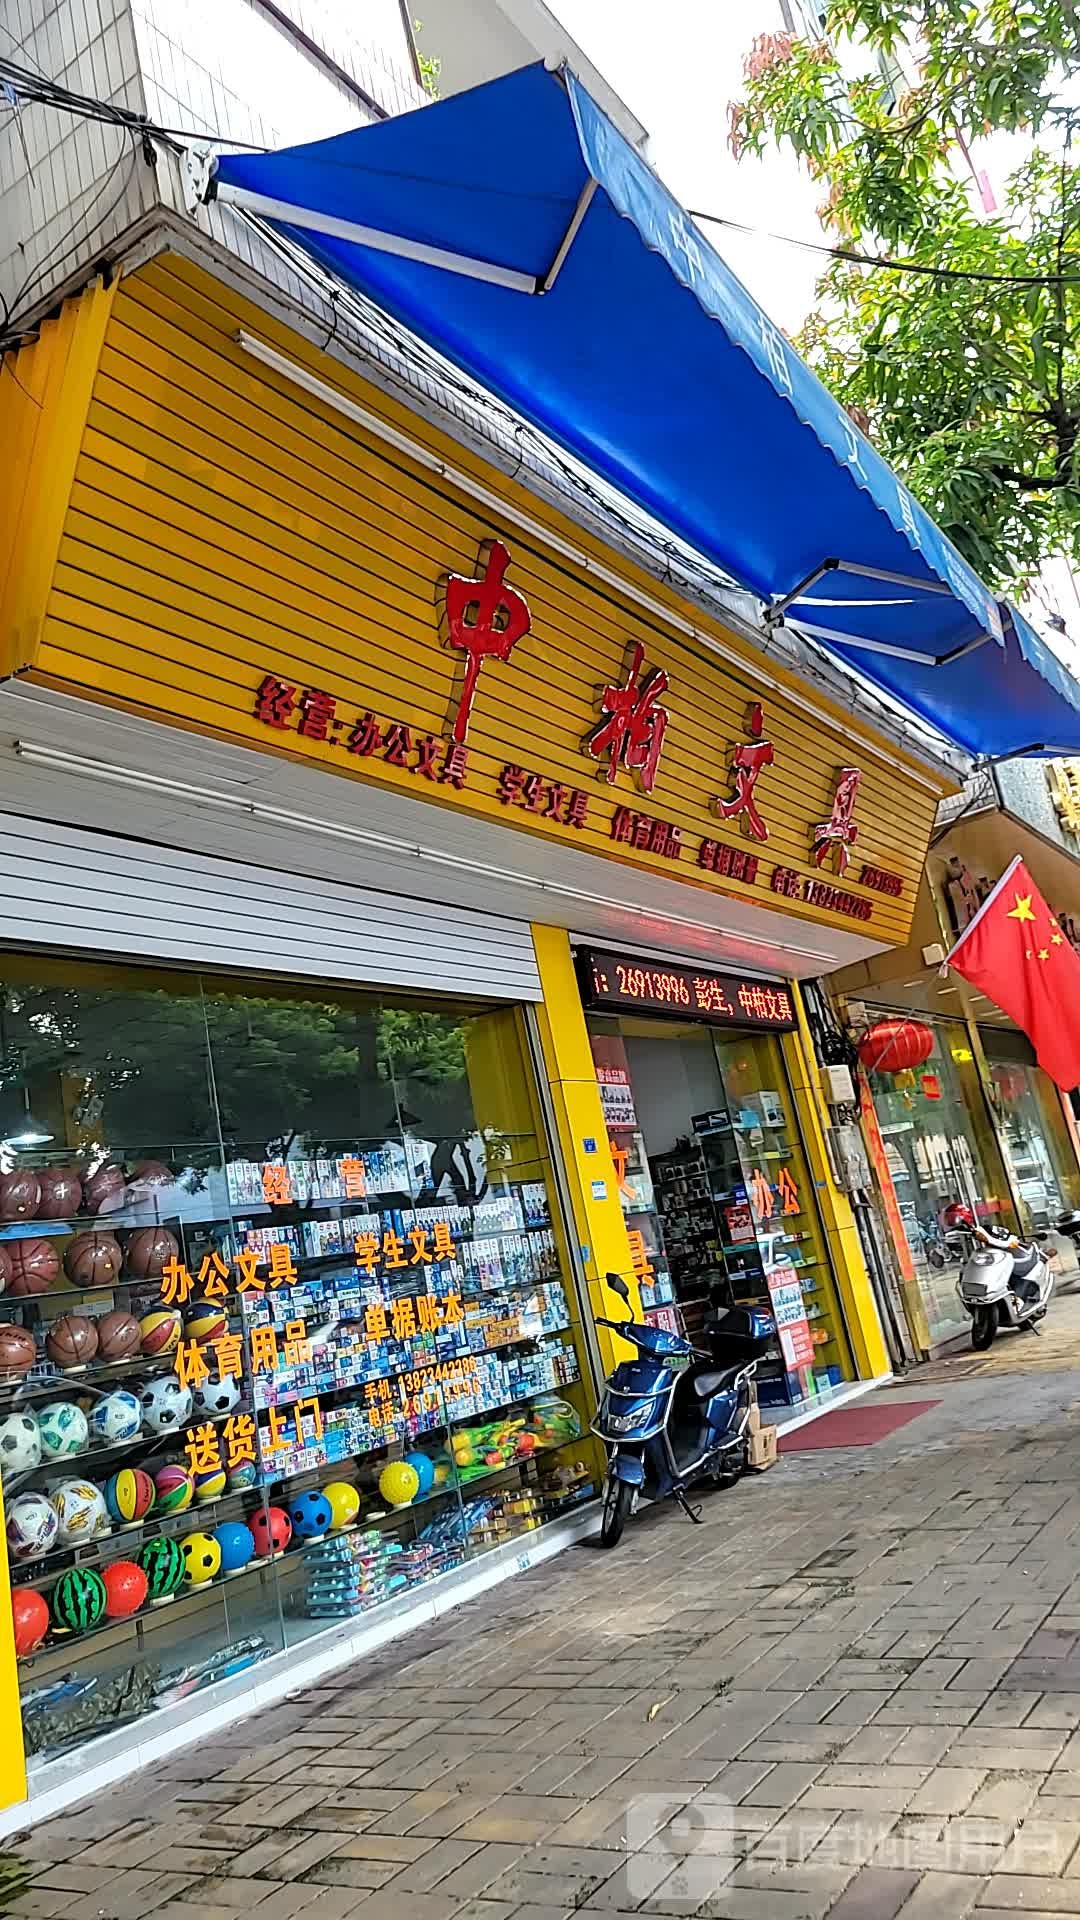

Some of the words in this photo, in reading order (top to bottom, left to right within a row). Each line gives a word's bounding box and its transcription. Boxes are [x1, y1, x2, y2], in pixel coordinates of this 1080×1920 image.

[496, 764, 590, 830] 学生文具
[616, 965, 690, 1005] 26913996
[751, 1166, 801, 1220] 办公
[160, 1244, 298, 1305] 办公文具
[353, 1221, 457, 1275] 学生文具
[363, 1288, 465, 1346] 单据账本
[173, 1318, 314, 1392] 体育用品
[184, 1396, 325, 1477] 送货上门
